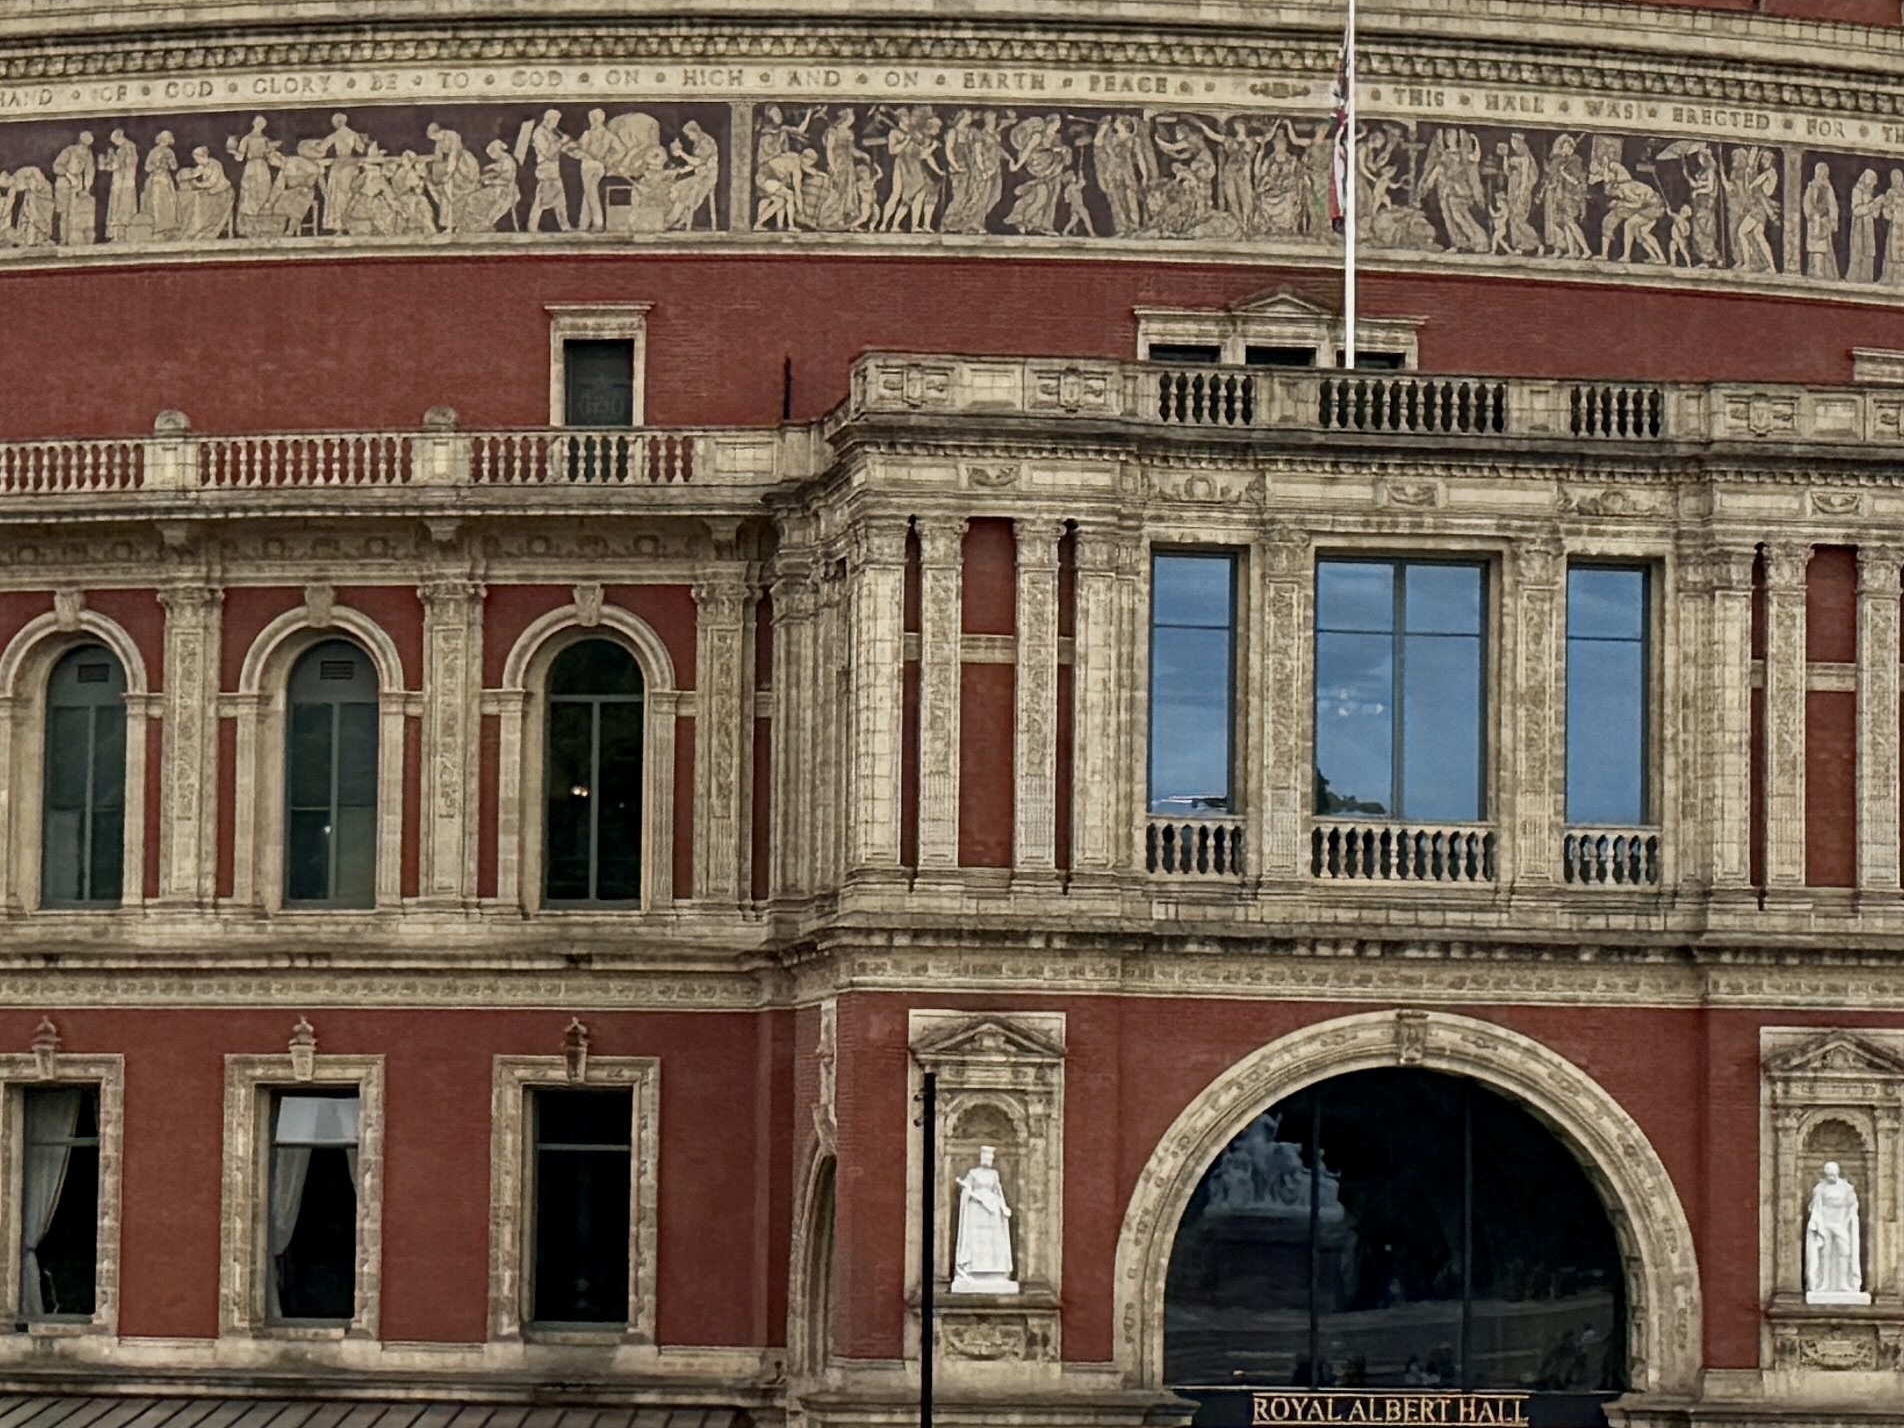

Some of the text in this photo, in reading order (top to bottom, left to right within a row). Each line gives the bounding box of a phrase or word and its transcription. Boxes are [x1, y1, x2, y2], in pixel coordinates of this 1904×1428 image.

[100, 85, 128, 103] OF
[165, 81, 214, 99] GOD
[253, 74, 331, 96] GLORY
[369, 72, 398, 92] BE
[437, 71, 470, 89] TO
[511, 69, 563, 88] GOD
[605, 69, 639, 86] ON
[682, 68, 744, 87] HIGH
[787, 69, 841, 88] AND
[884, 70, 919, 88] ON
[963, 72, 1045, 90] EARTH
[1089, 74, 1168, 94] PEACE
[1393, 87, 1445, 108] THIS
[1485, 93, 1544, 114] HALL
[1584, 99, 1634, 120] WAS
[1672, 106, 1771, 131] ERECTED
[1806, 117, 1846, 140] FOR
[1253, 1397, 1529, 1423] ROYAL ALBERT HALL
